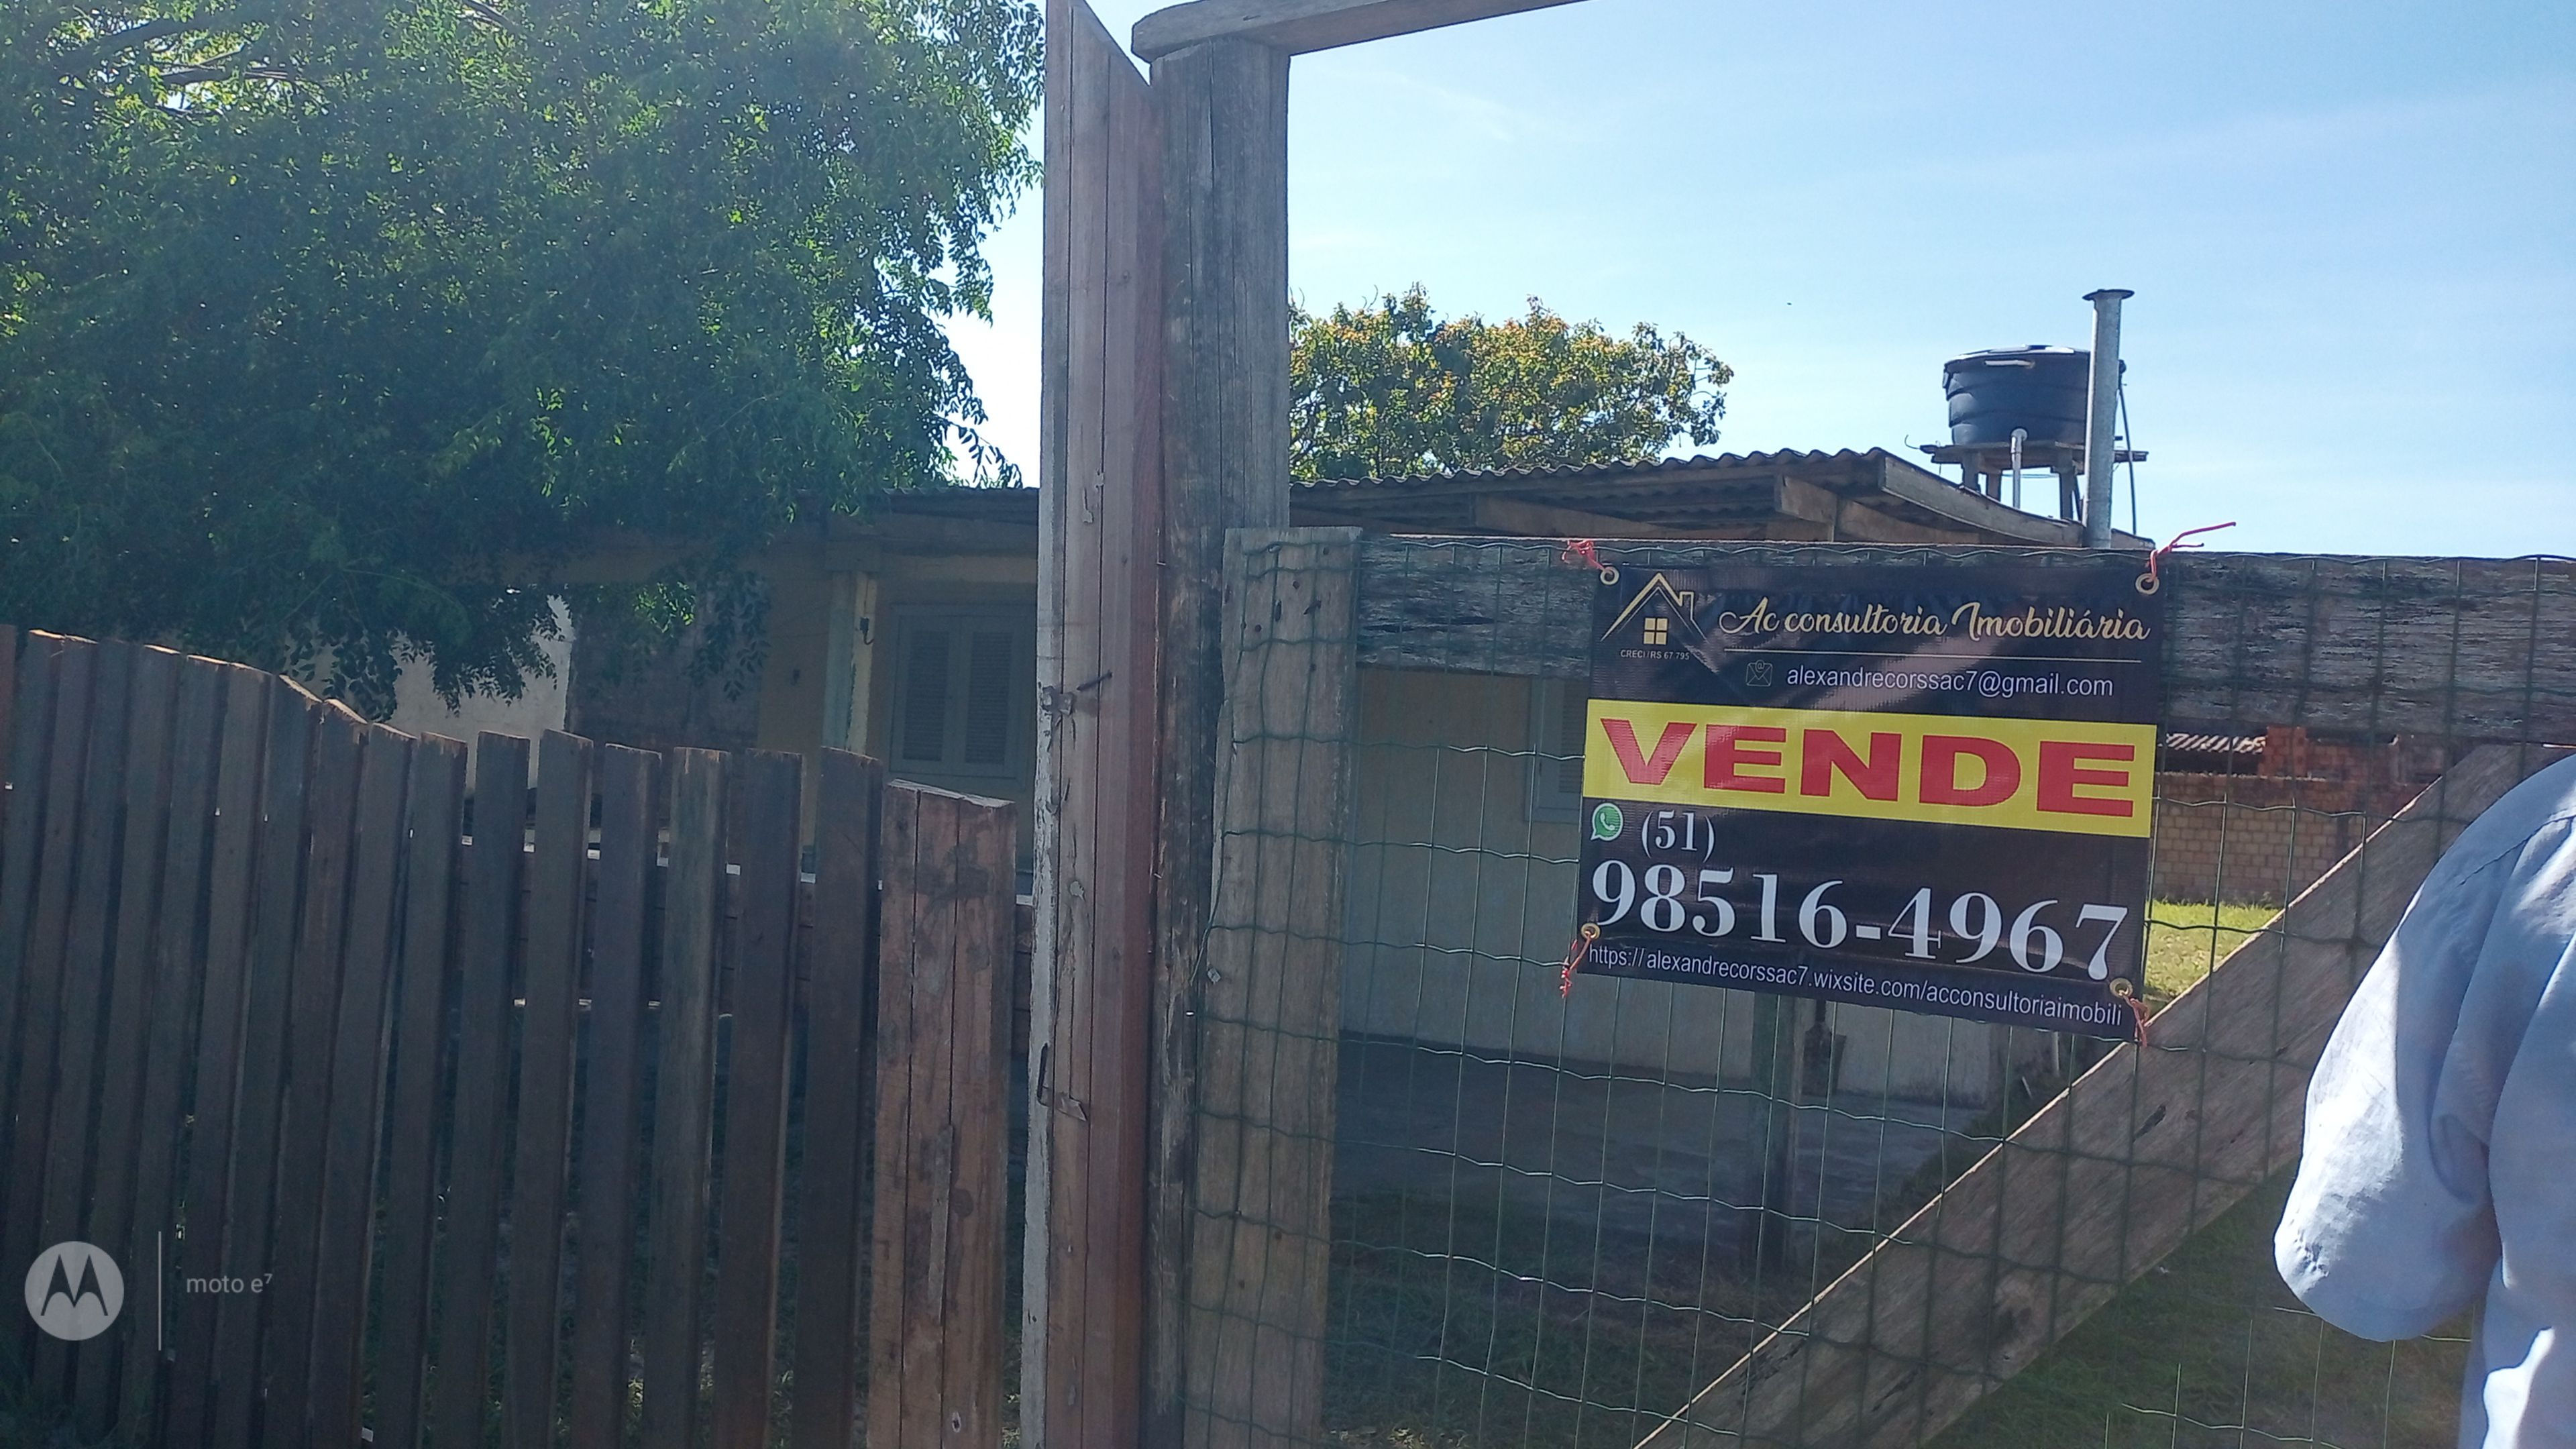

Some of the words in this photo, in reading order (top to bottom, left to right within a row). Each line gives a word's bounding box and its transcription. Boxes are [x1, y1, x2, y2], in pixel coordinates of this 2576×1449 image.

[1719, 596, 1780, 634] Ac
[1784, 603, 1948, 635] consultoria
[1951, 602, 2151, 641] Imobiliária
[1786, 665, 2113, 698] alexandrecorssac7@gmail.com
[1599, 718, 2136, 818] VENDE
[1641, 809, 1716, 860] (51)
[1591, 859, 2128, 981] 98516-4967
